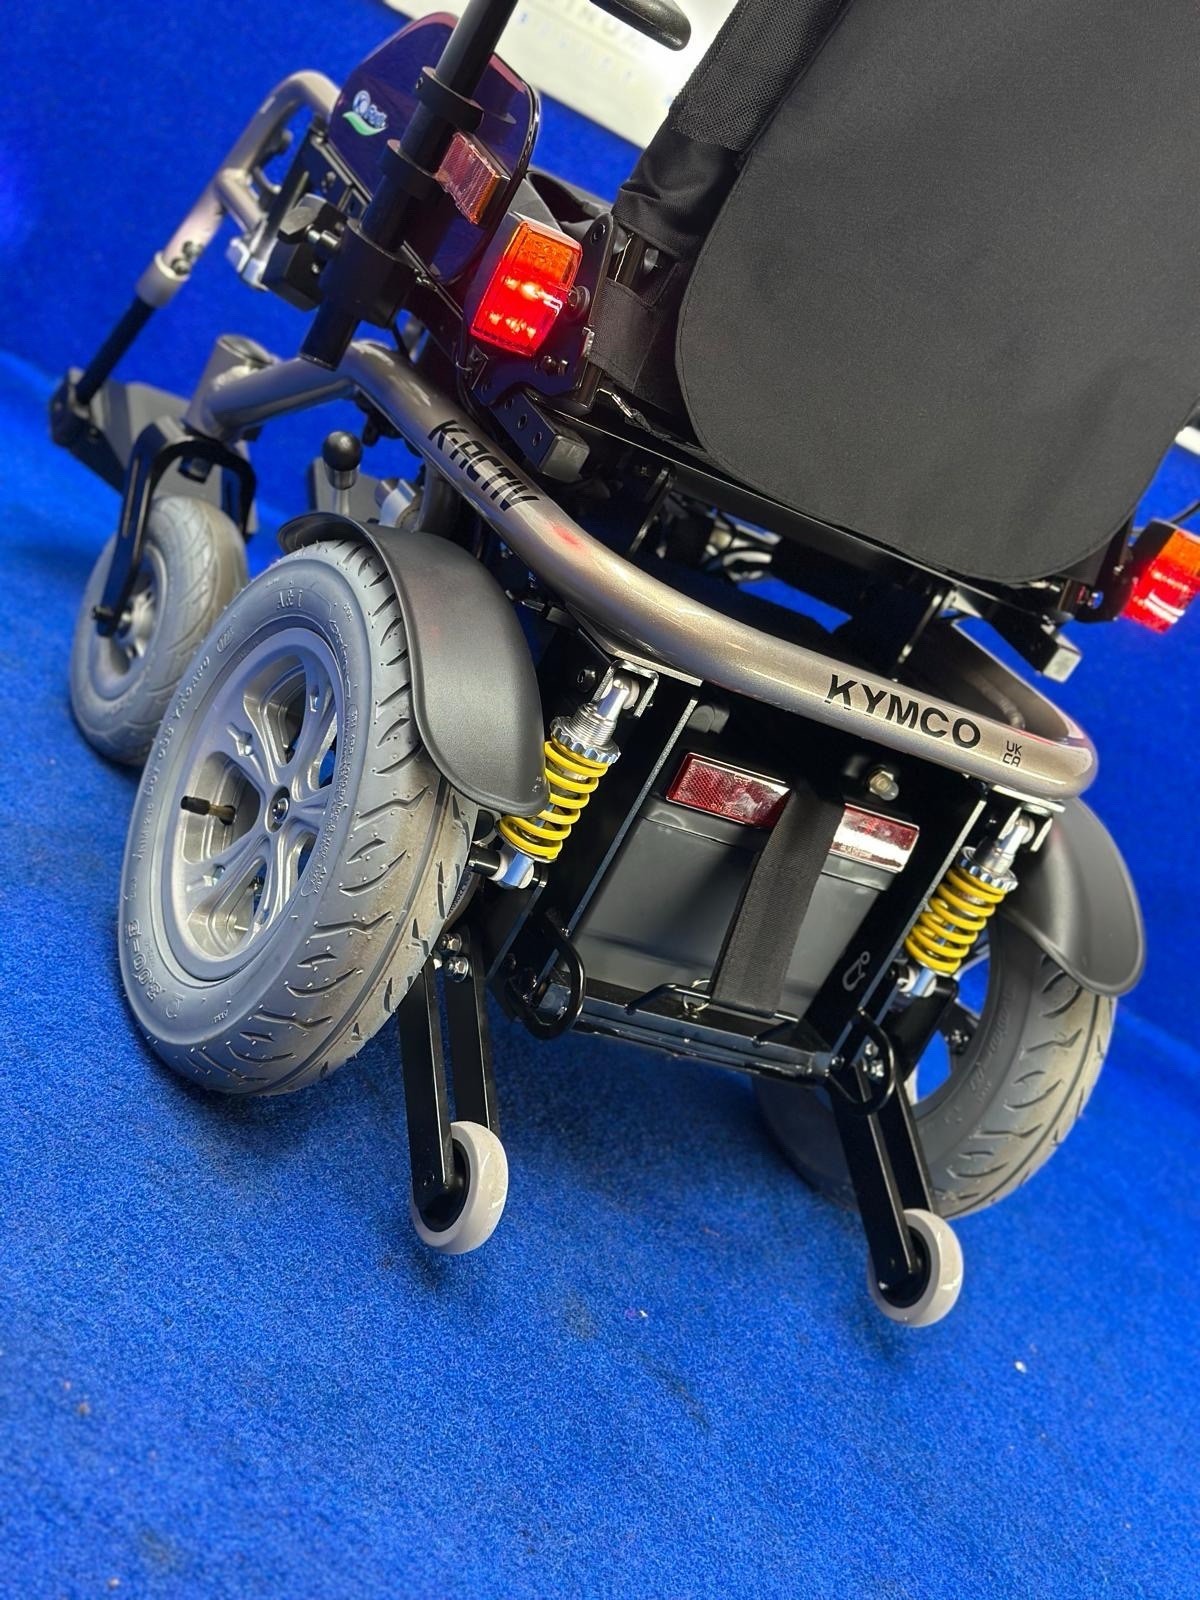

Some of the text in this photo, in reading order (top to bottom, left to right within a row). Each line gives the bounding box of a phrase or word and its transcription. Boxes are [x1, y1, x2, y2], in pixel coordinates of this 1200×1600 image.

[427, 419, 540, 511] K-ACTIV
[824, 674, 981, 749] KYMCO
[1002, 752, 1020, 767] CA
[1006, 740, 1022, 756] UK
